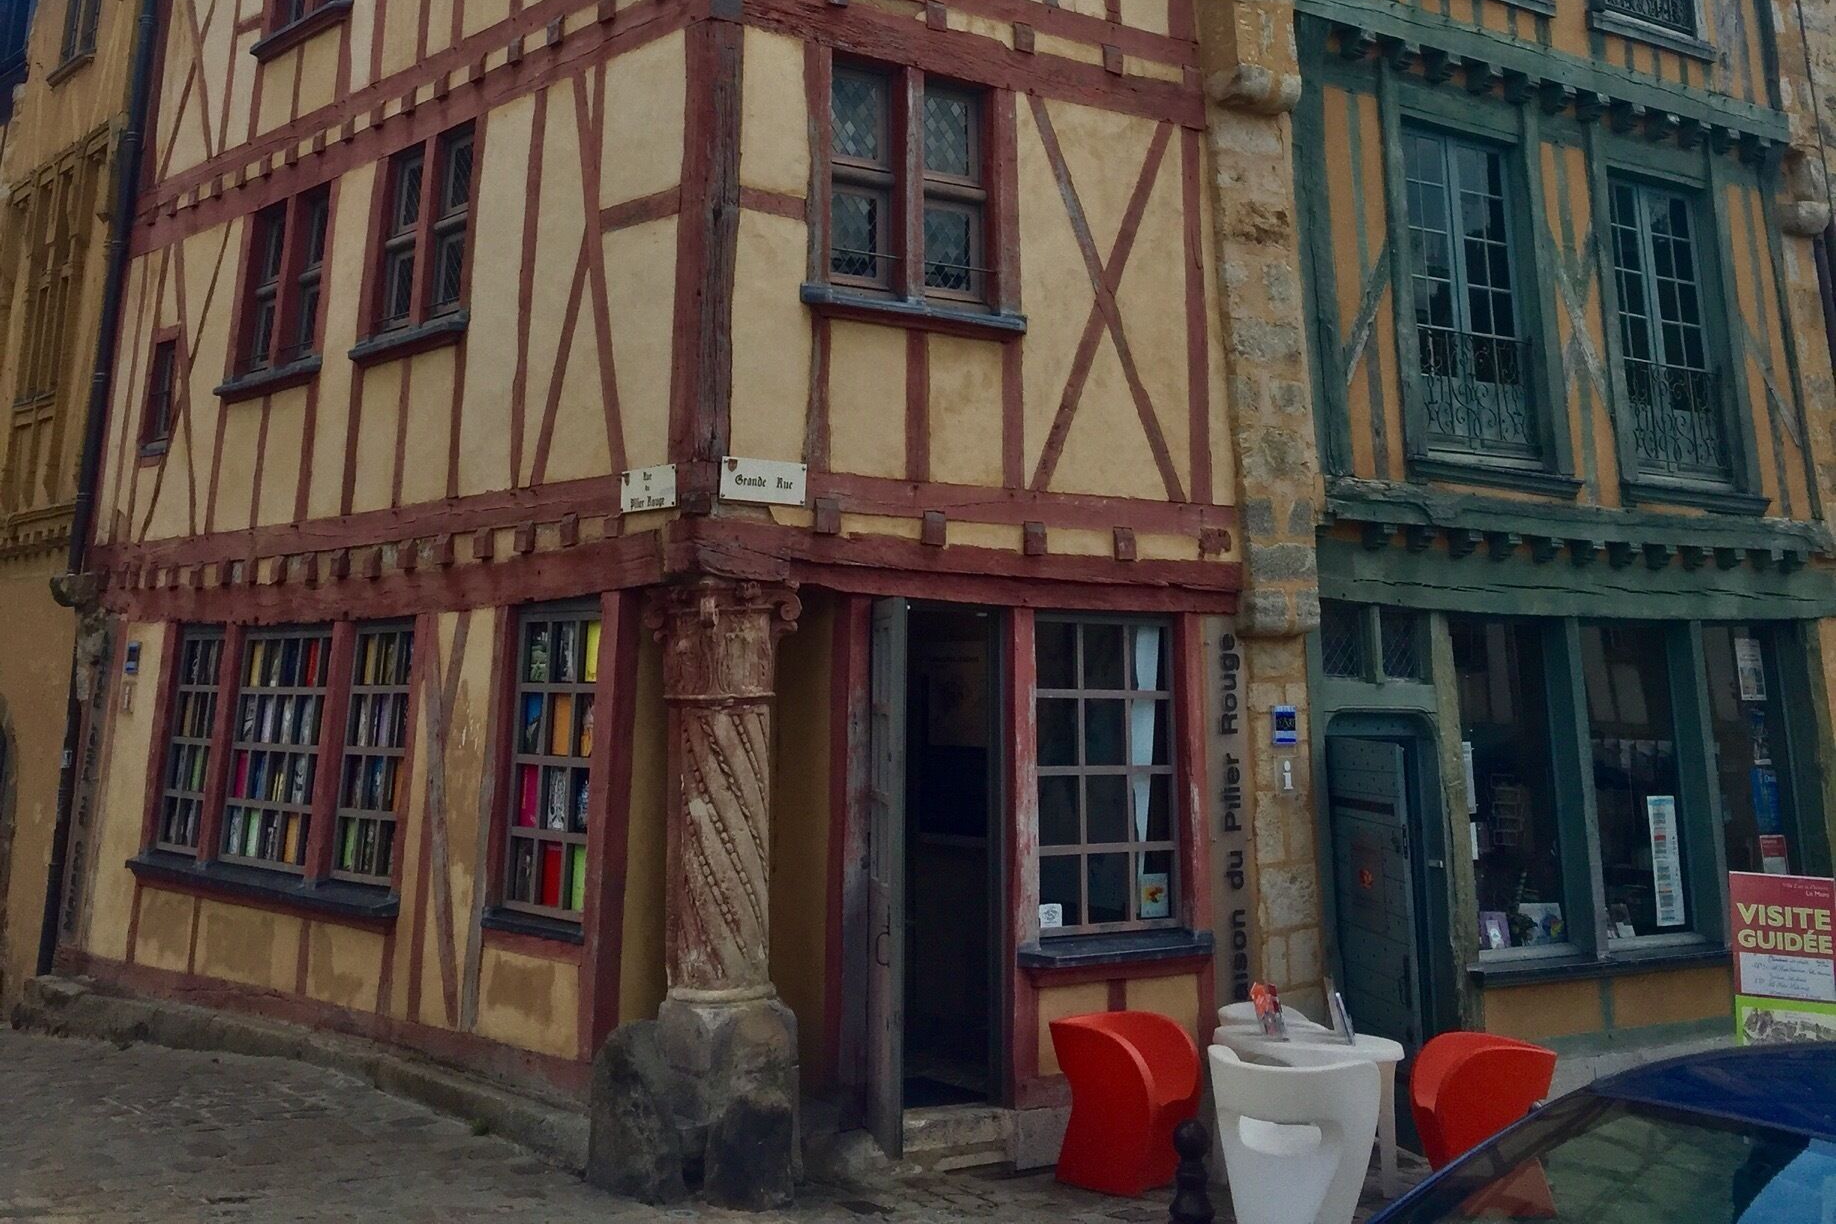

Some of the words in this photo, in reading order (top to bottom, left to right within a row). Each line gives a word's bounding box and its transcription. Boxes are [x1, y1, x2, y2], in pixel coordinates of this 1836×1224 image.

[735, 473, 767, 488] Grande
[776, 476, 793, 490] Rue
[1220, 633, 1241, 735] Rouge
[1224, 752, 1242, 833] Pilier
[1226, 849, 1245, 890] du
[1736, 902, 1832, 931] VISITE
[1233, 908, 1250, 1003] aison
[1737, 929, 1834, 955] GUIDÉE
